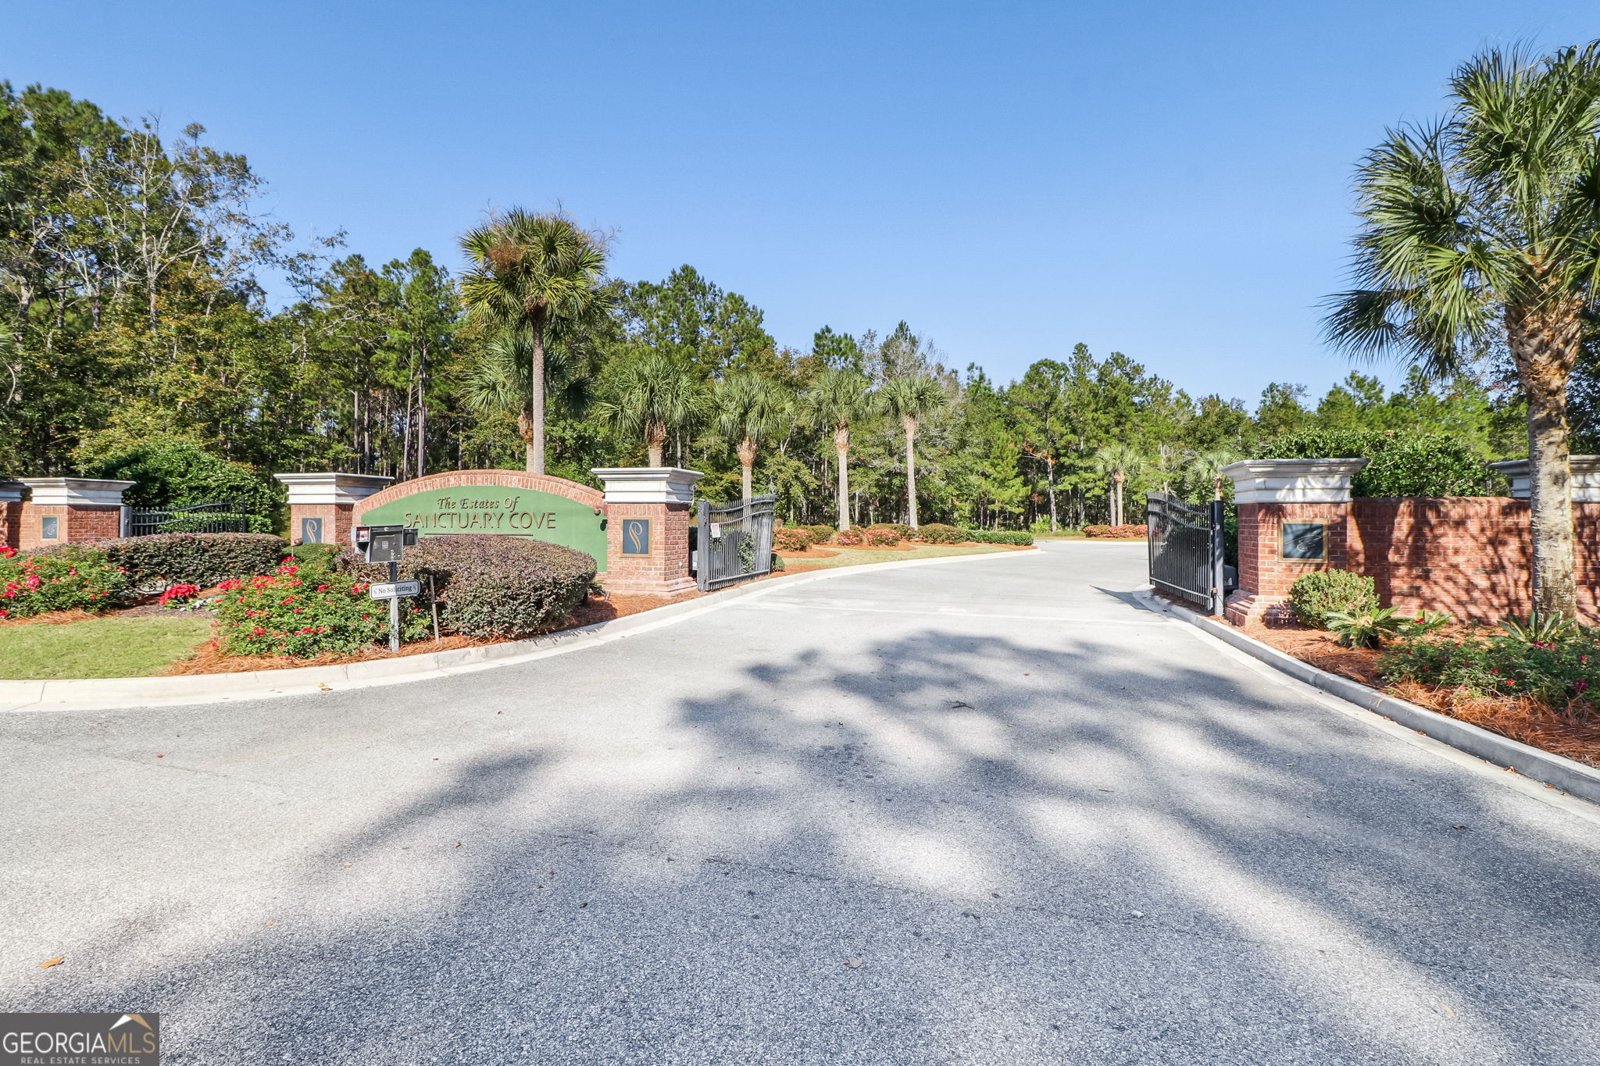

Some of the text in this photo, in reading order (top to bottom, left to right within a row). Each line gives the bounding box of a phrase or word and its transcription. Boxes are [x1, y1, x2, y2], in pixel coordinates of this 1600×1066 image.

[437, 496, 520, 512] The Estates Of
[404, 512, 556, 529] SANCTUARY COVE
